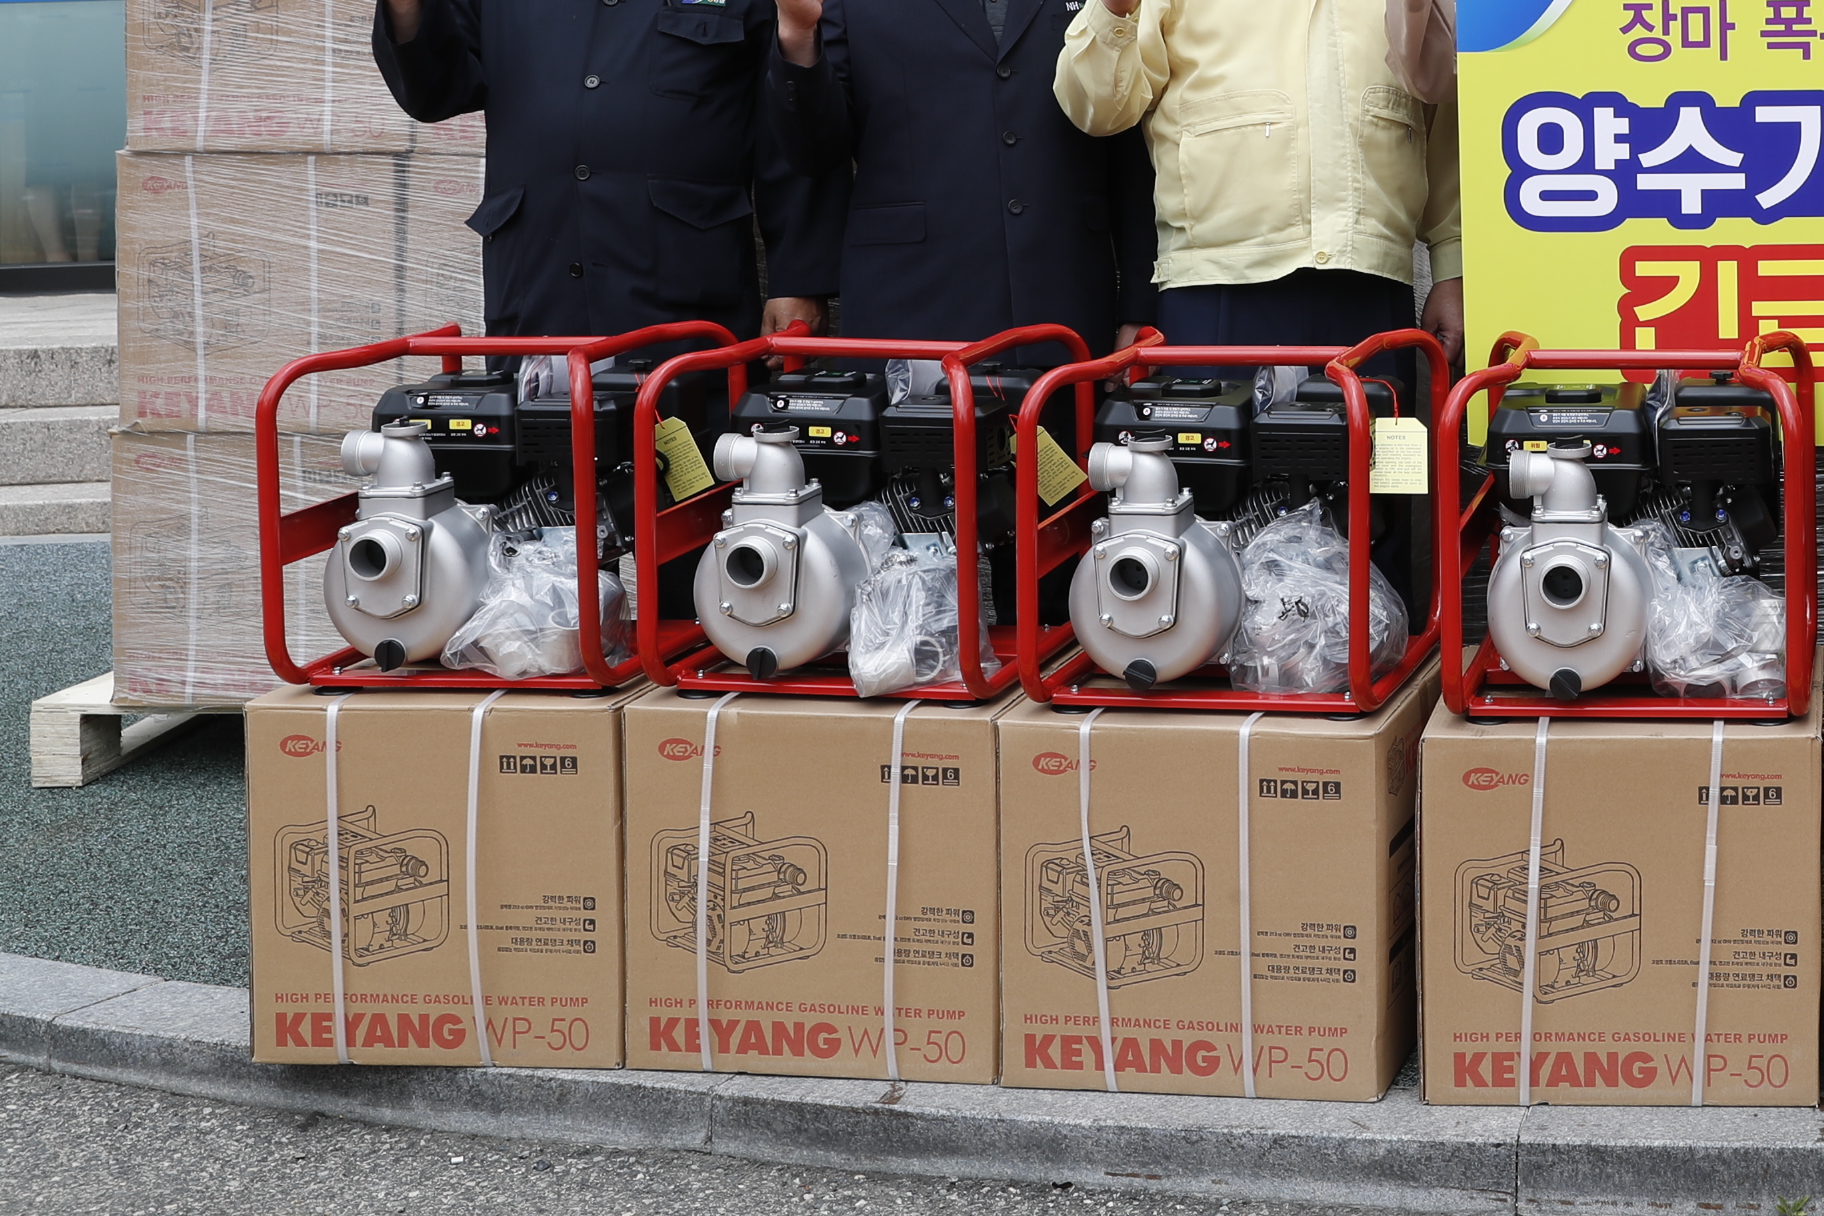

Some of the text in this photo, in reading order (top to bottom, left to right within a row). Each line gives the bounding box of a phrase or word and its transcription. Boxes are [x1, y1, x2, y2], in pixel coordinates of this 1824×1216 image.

[1065, 1, 1080, 11] NH
[517, 741, 577, 750] www.keyang.com
[1277, 766, 1340, 775] www.keyang.com
[1464, 769, 1530, 789] KEYANG
[542, 895, 581, 905] 강력한 파워
[535, 916, 581, 926] 견고한 내구성
[1301, 923, 1341, 932] 강력한 파워
[1741, 929, 1782, 938] 강력한 파워
[1293, 944, 1341, 954] 견고한 내구성
[1732, 951, 1782, 960] 견고한 내구성
[275, 992, 589, 1008] HIGH PEFORMANCE GASOLIE WATER PUMP
[649, 997, 966, 1020] HIGH PRFORMANCE GASOLINE WTER PUMP
[276, 1012, 589, 1051] KEYANG WP-50
[1023, 1014, 1349, 1038] HIGH PERFRMANCE GASOLIN WATER PUMP
[650, 1017, 966, 1064] KEYANG WP-50
[1453, 1031, 1789, 1044] HIGH PERORMANCE GASOLINE ATER PUMP
[1025, 1034, 1348, 1082] KEYANG WP-50
[1454, 1051, 1789, 1088] KEYANG WP-50
